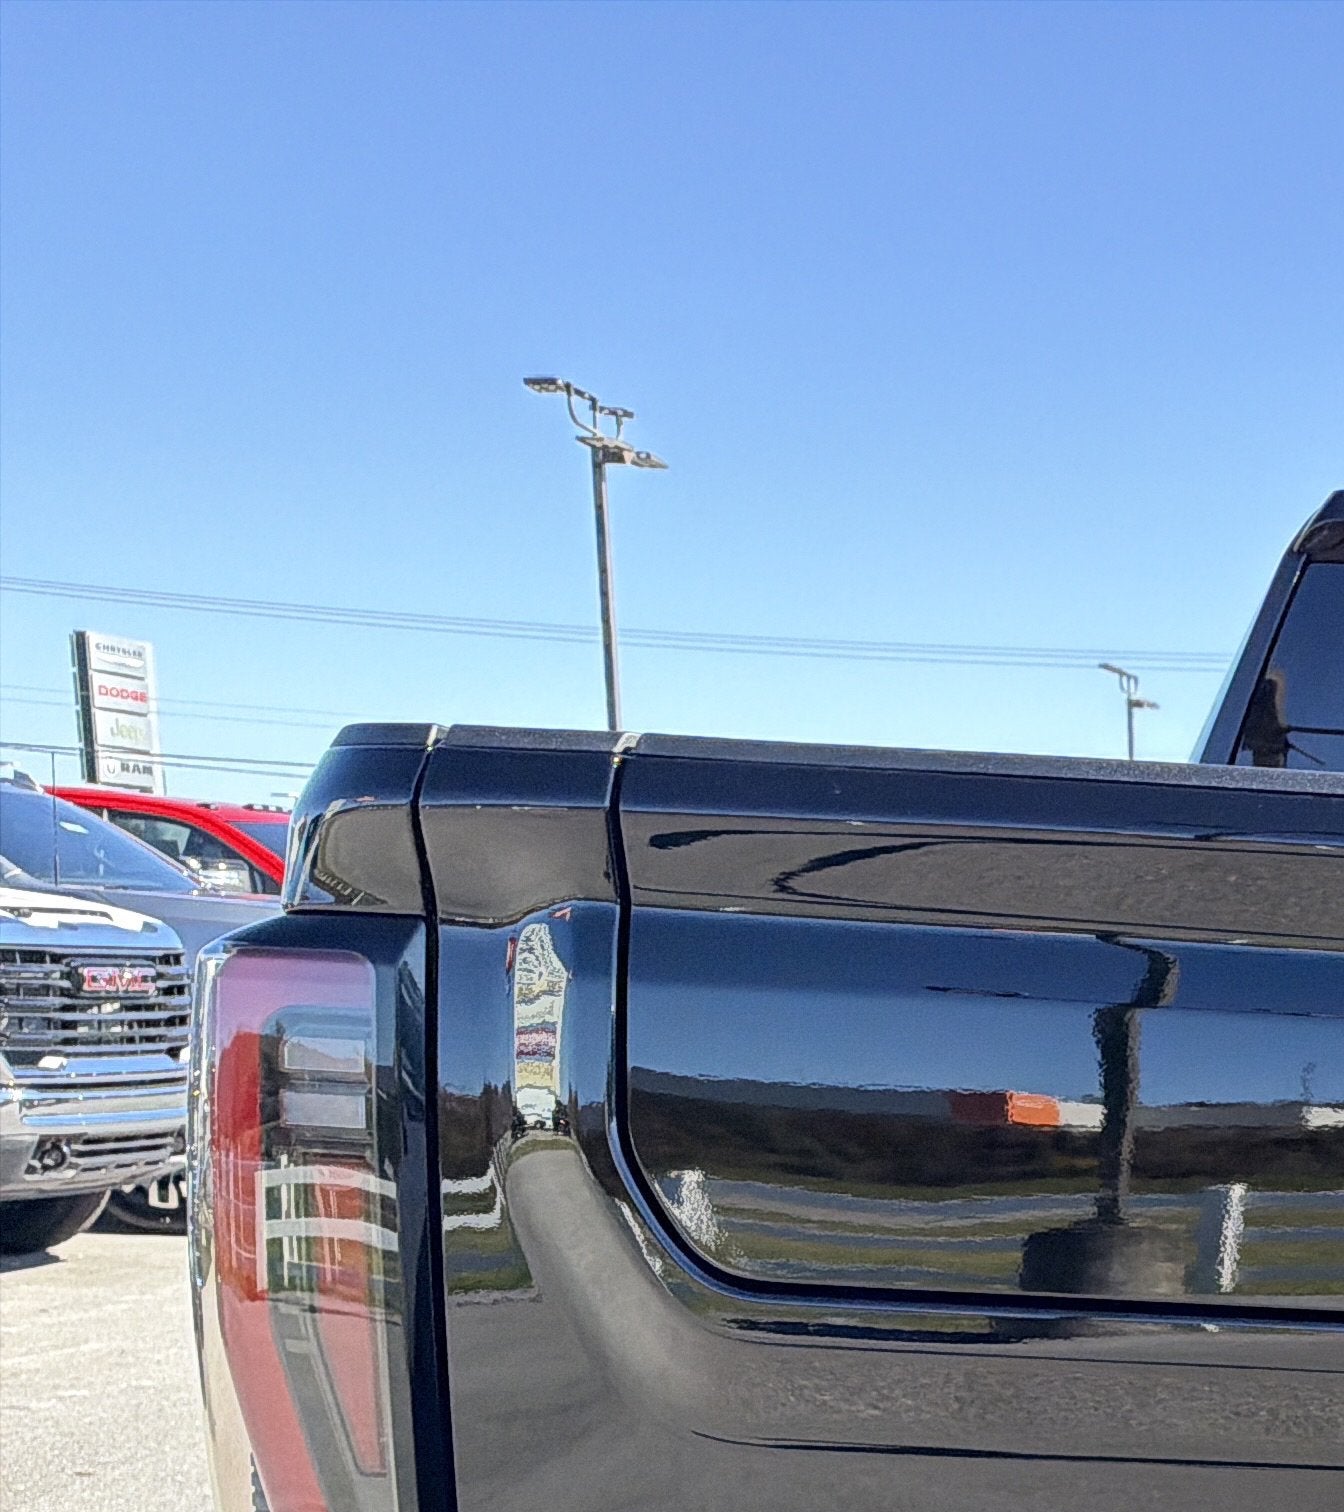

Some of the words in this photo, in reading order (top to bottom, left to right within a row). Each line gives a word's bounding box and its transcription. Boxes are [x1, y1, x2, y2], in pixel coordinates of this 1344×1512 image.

[98, 684, 148, 704] DODGE
[110, 717, 146, 742] Jeep
[120, 762, 154, 776] RAM
[82, 967, 156, 992] GMC
